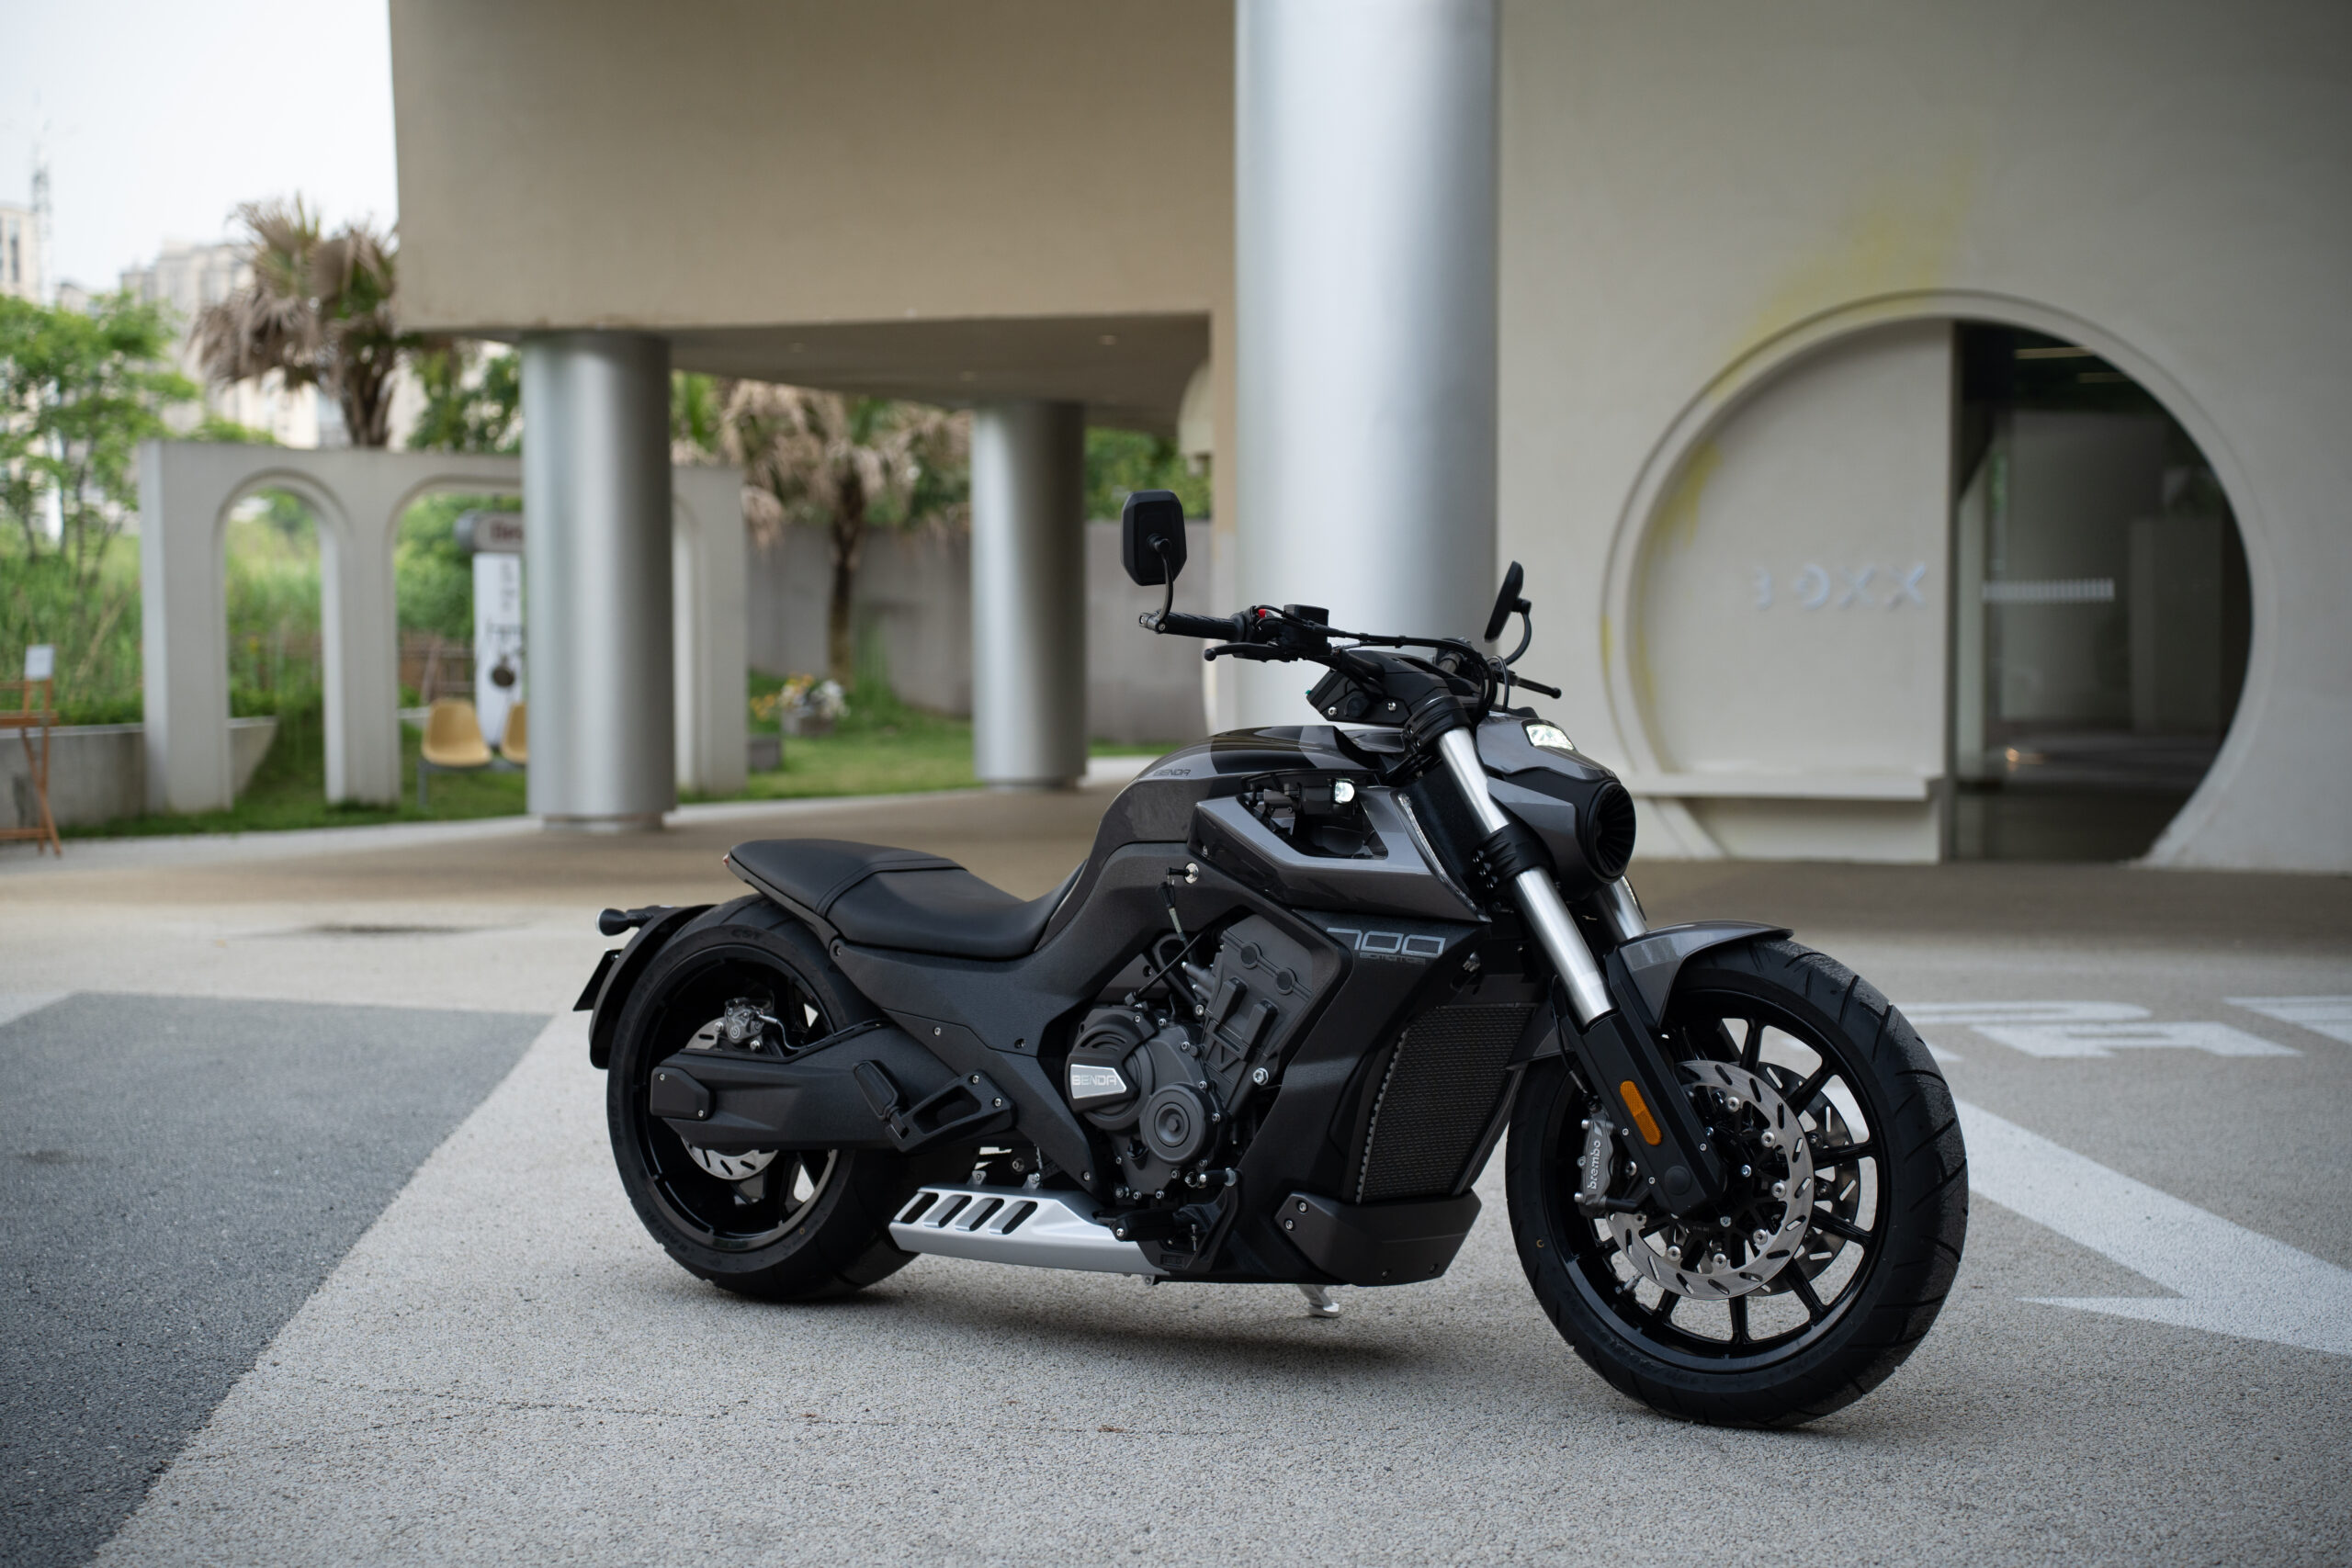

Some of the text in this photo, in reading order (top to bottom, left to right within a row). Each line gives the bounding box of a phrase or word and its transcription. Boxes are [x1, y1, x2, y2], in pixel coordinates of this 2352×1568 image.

[1326, 927, 1446, 958] 700
[1071, 1074, 1117, 1086] BENDA
[1587, 1139, 1601, 1190] brembo
